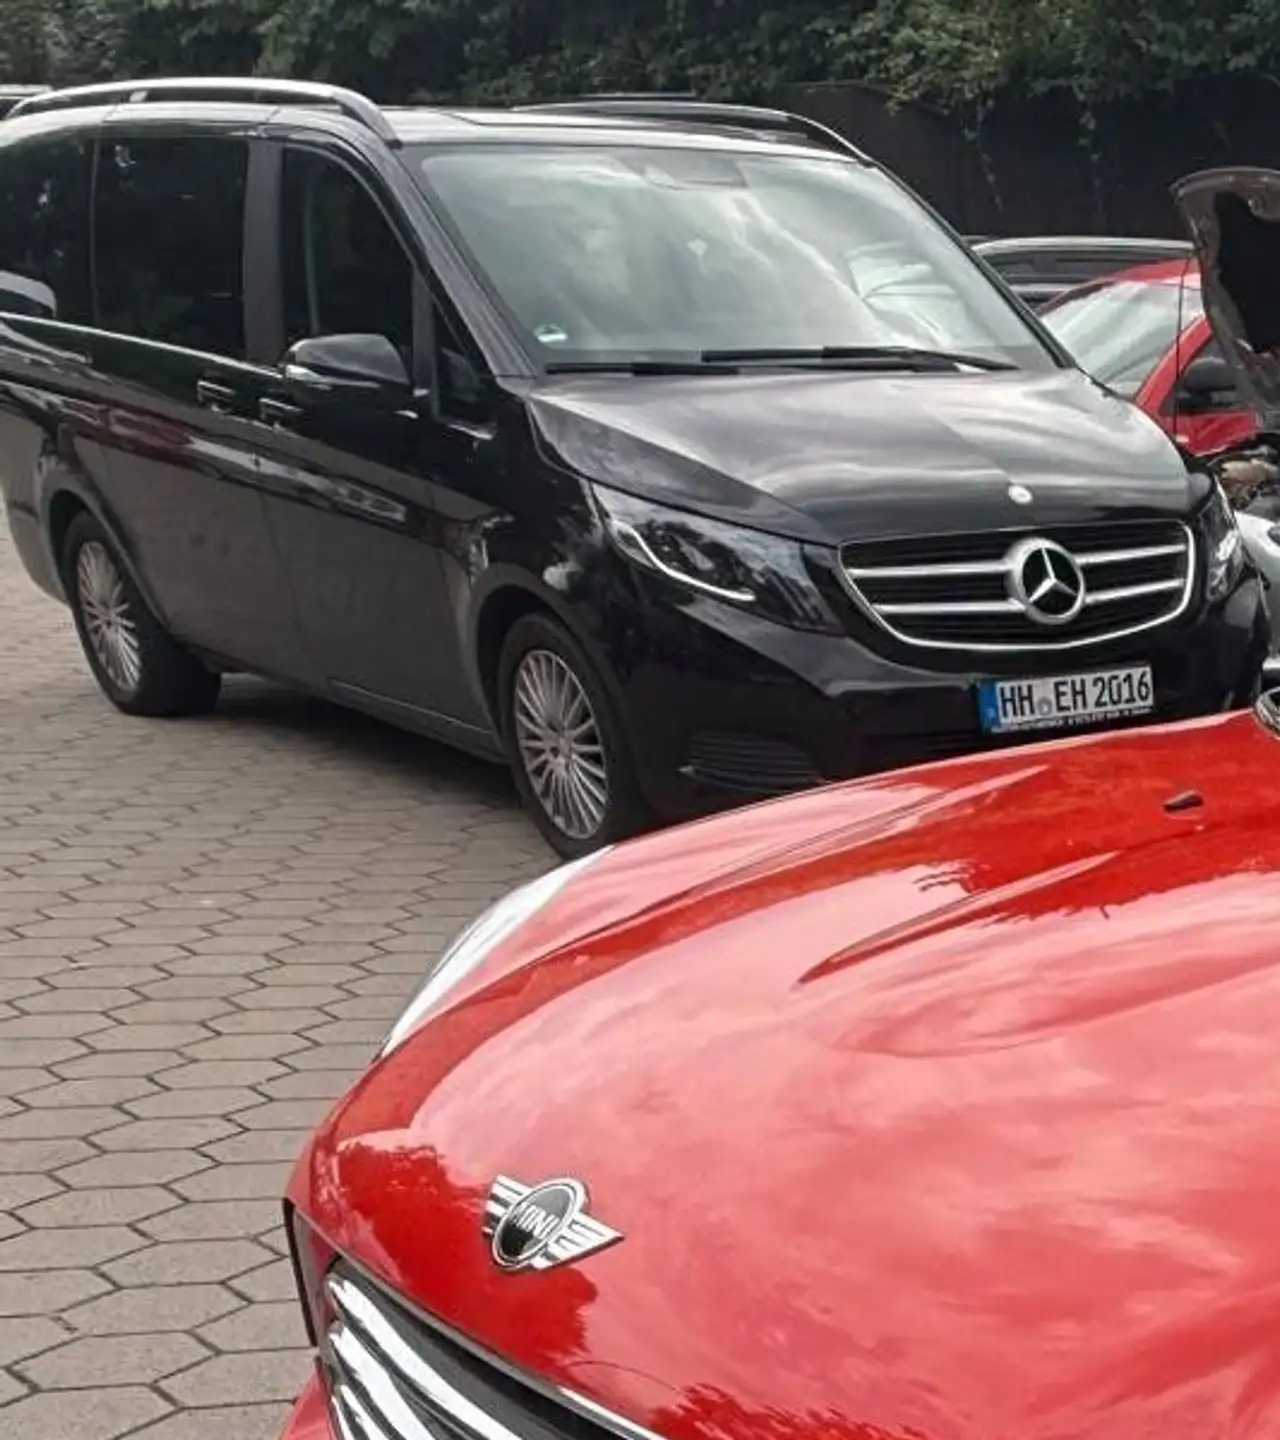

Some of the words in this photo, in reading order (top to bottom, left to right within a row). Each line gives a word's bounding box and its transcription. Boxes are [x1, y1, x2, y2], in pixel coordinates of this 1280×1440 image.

[999, 683, 1035, 718] HH
[1053, 678, 1088, 713] EH
[1092, 670, 1150, 708] 2016
